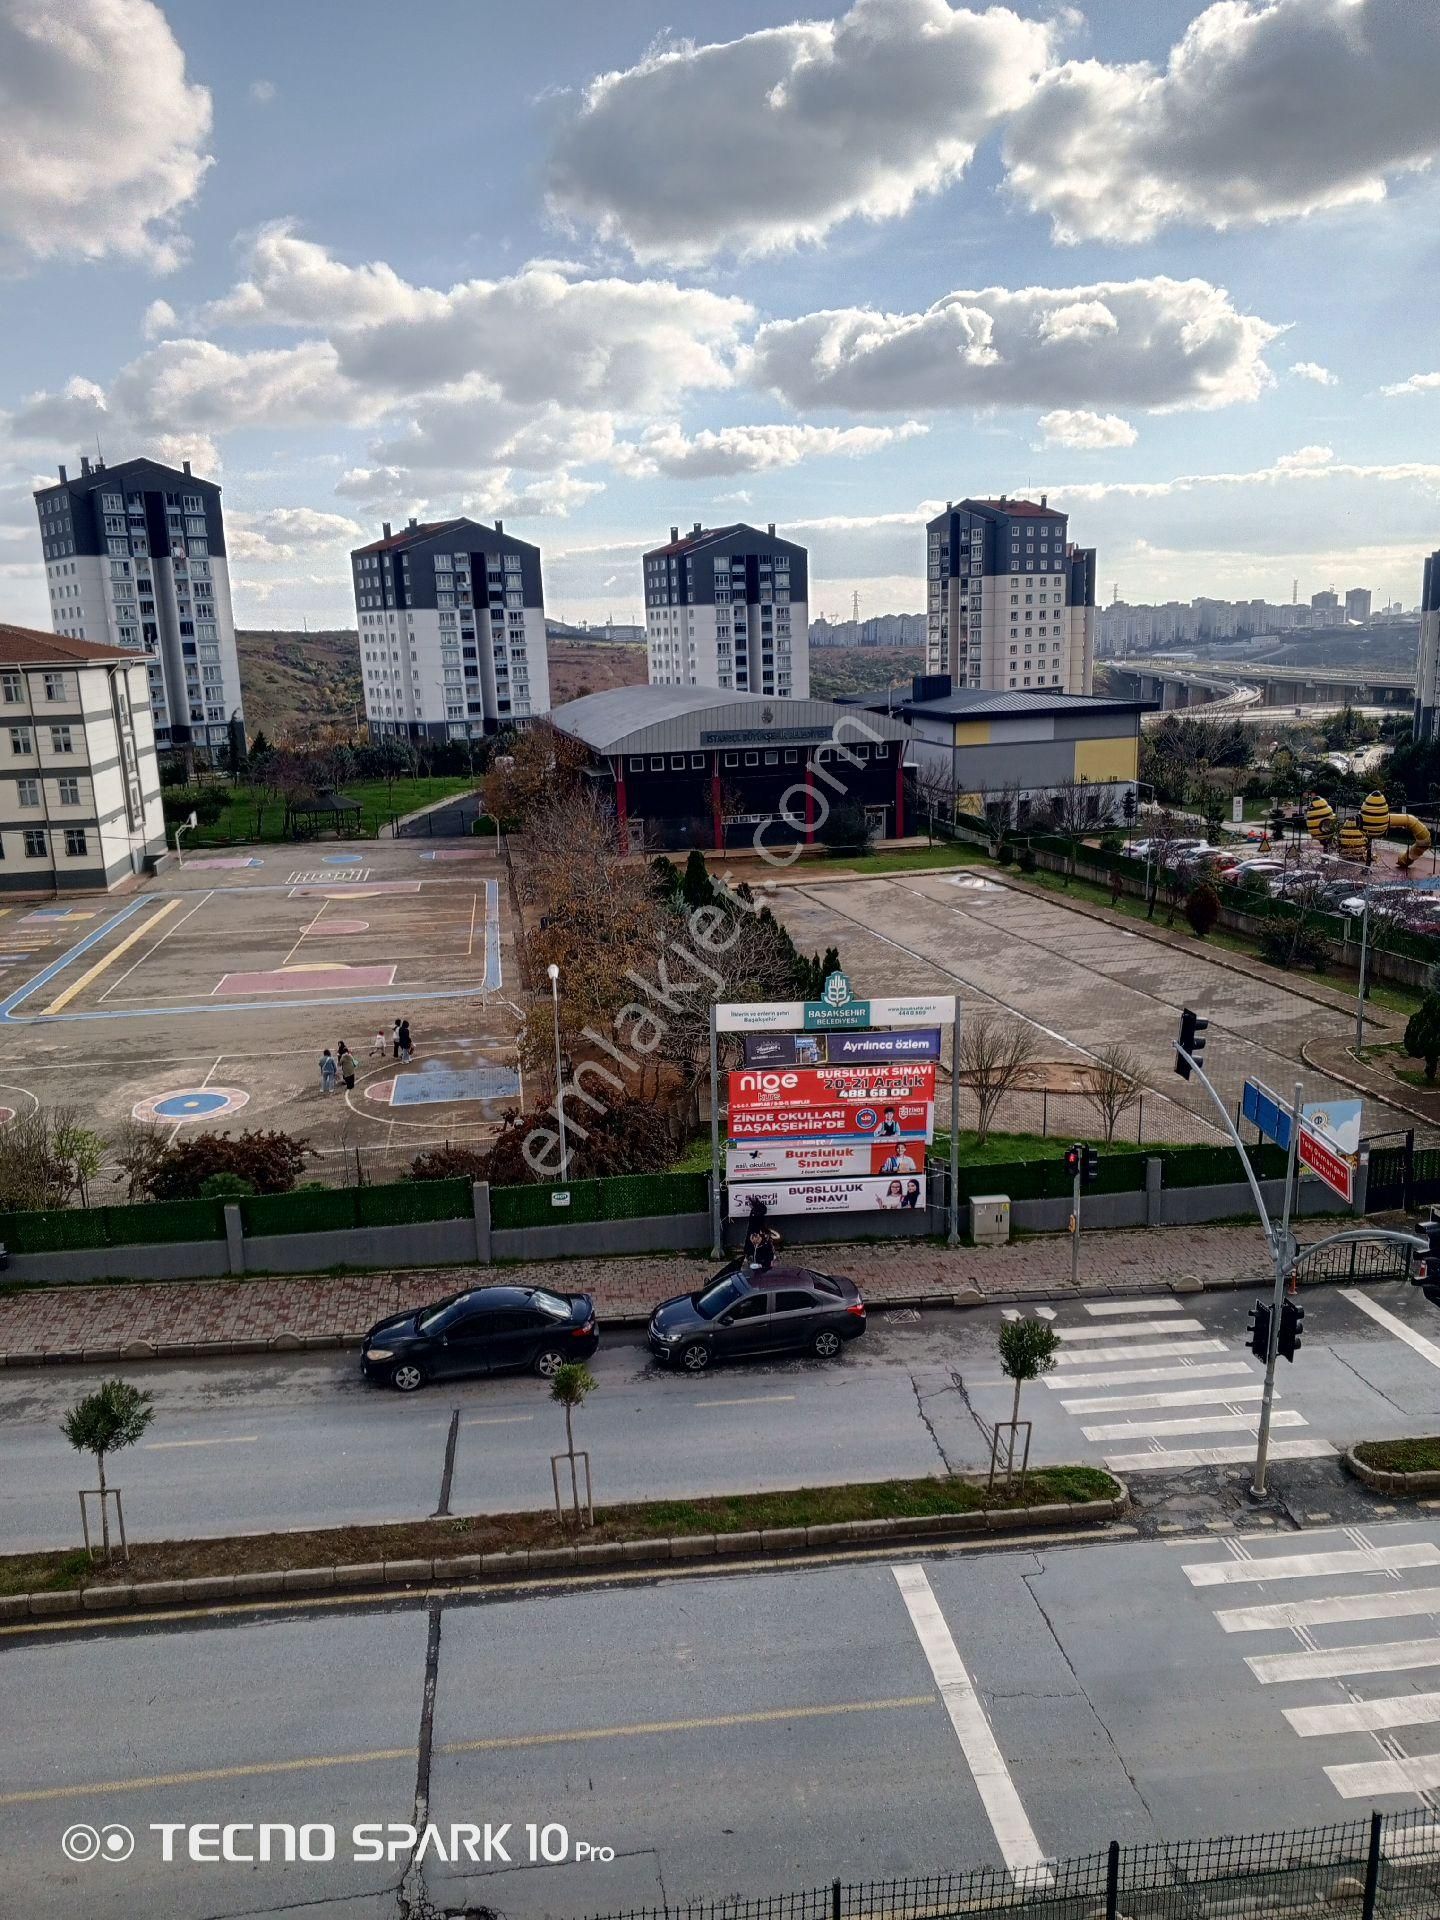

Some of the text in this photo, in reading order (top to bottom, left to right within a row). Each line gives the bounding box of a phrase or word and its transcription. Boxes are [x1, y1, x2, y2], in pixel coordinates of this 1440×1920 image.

[843, 1039, 929, 1053] Ayrılınca özlem
[816, 1065, 932, 1079] BURSLULUK SINAVI
[740, 1071, 798, 1093] nige
[823, 1074, 925, 1090] 20-21 Aralık
[839, 1088, 910, 1098] 488 68 00
[733, 1110, 845, 1122] ZİNDE OKULLARI
[733, 1120, 845, 1133] BAŞAKŞEHİR'DE
[785, 1148, 854, 1159] Bursluluk
[798, 1159, 843, 1168] Sınavı
[789, 1184, 863, 1195] BURSLULUK
[805, 1194, 848, 1204] SINAVI
